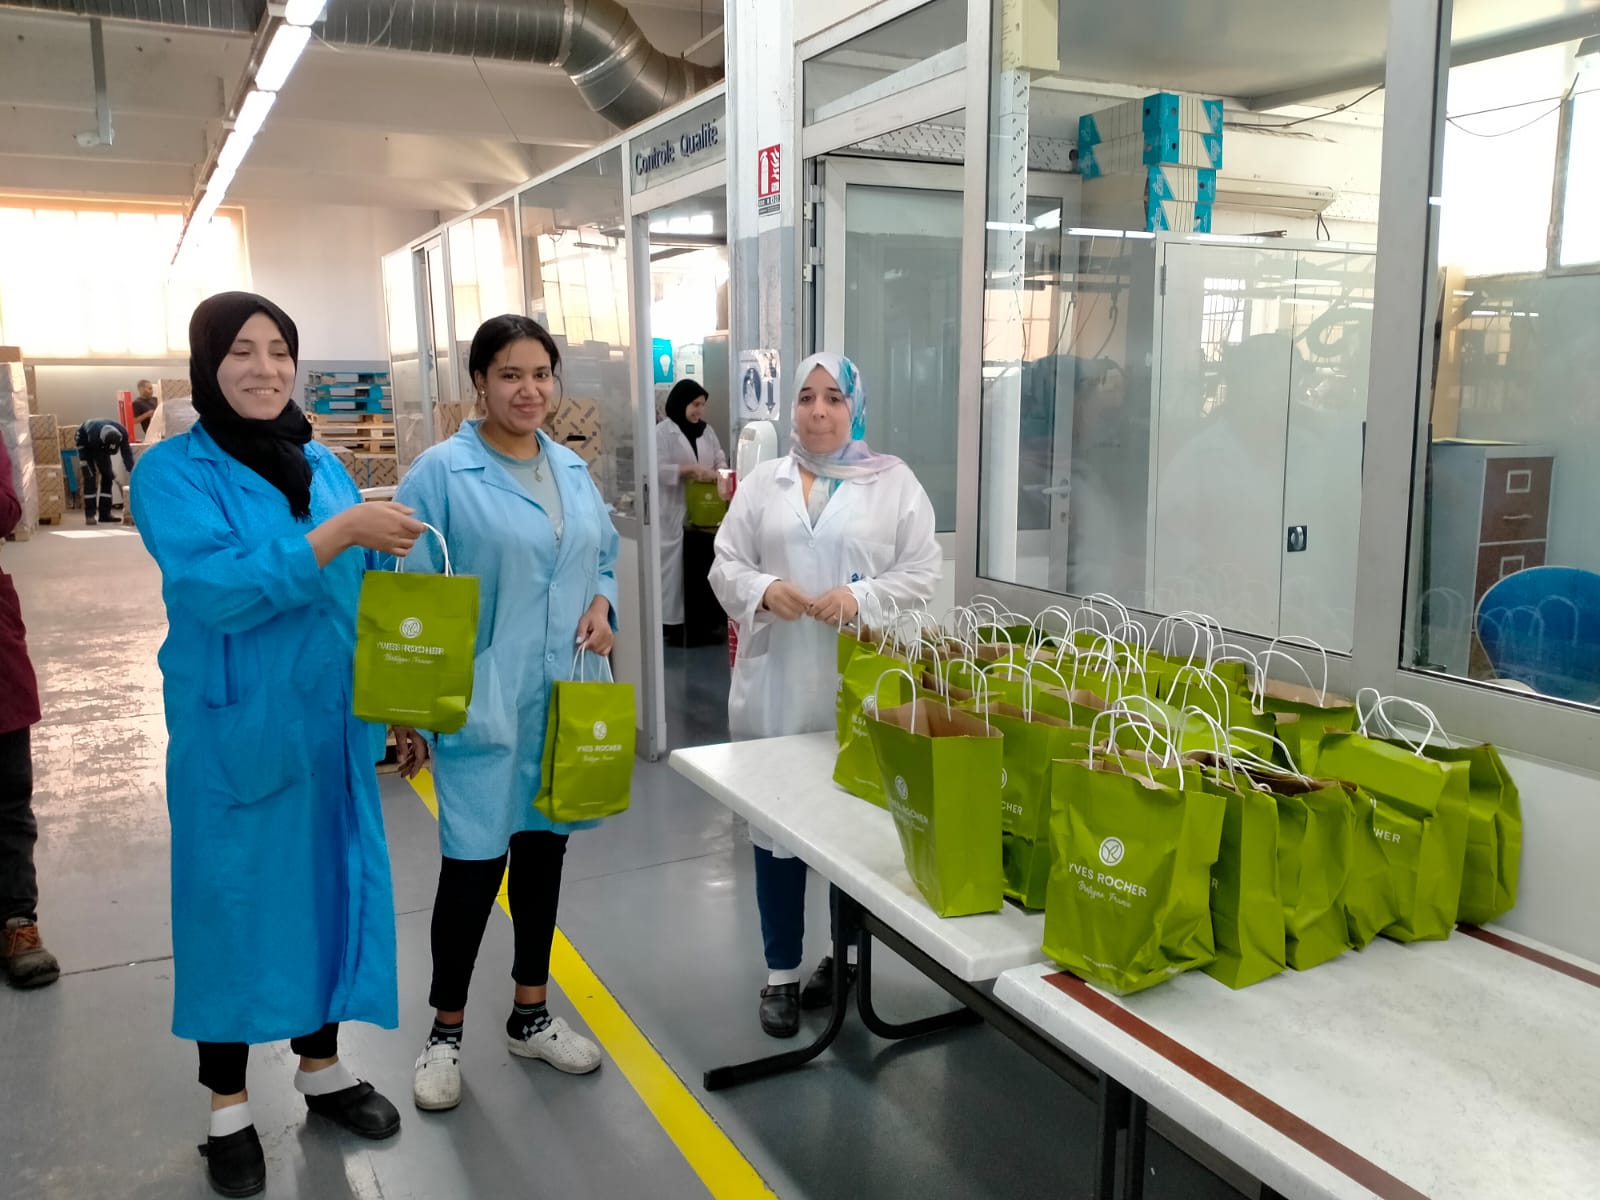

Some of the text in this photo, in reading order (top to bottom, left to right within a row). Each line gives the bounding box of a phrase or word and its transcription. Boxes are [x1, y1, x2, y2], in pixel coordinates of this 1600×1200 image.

[635, 118, 718, 176] Contrôle Qualité
[402, 644, 445, 655] ROCHER
[1068, 863, 1148, 897] YVES ROCHER
